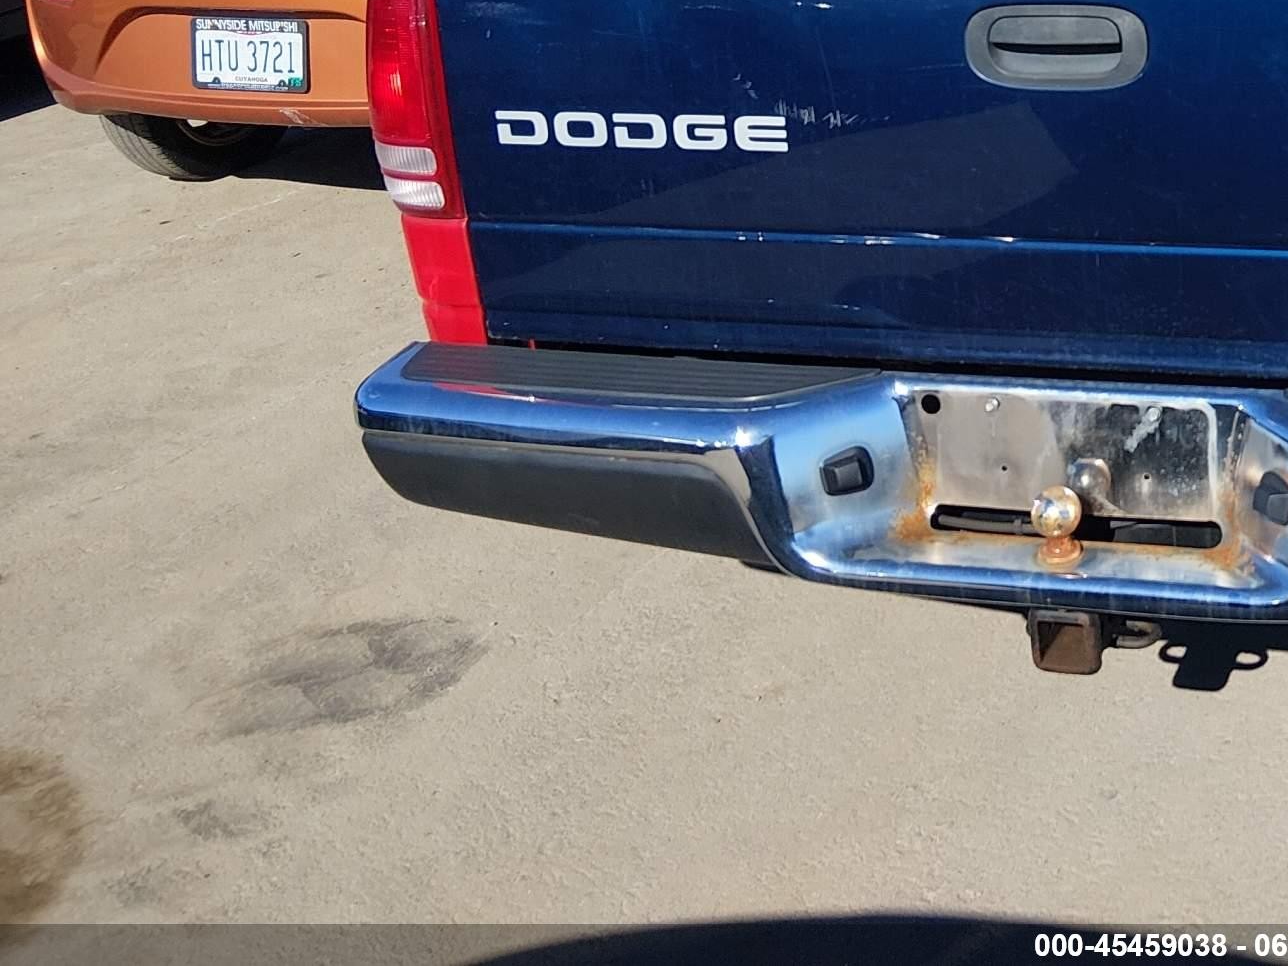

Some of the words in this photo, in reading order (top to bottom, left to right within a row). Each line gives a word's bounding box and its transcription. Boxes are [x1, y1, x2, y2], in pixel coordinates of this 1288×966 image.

[201, 39, 239, 72] HTU
[247, 40, 295, 74] 3721
[235, 75, 268, 83] CUYAHOGA
[495, 110, 789, 152] DODGE
